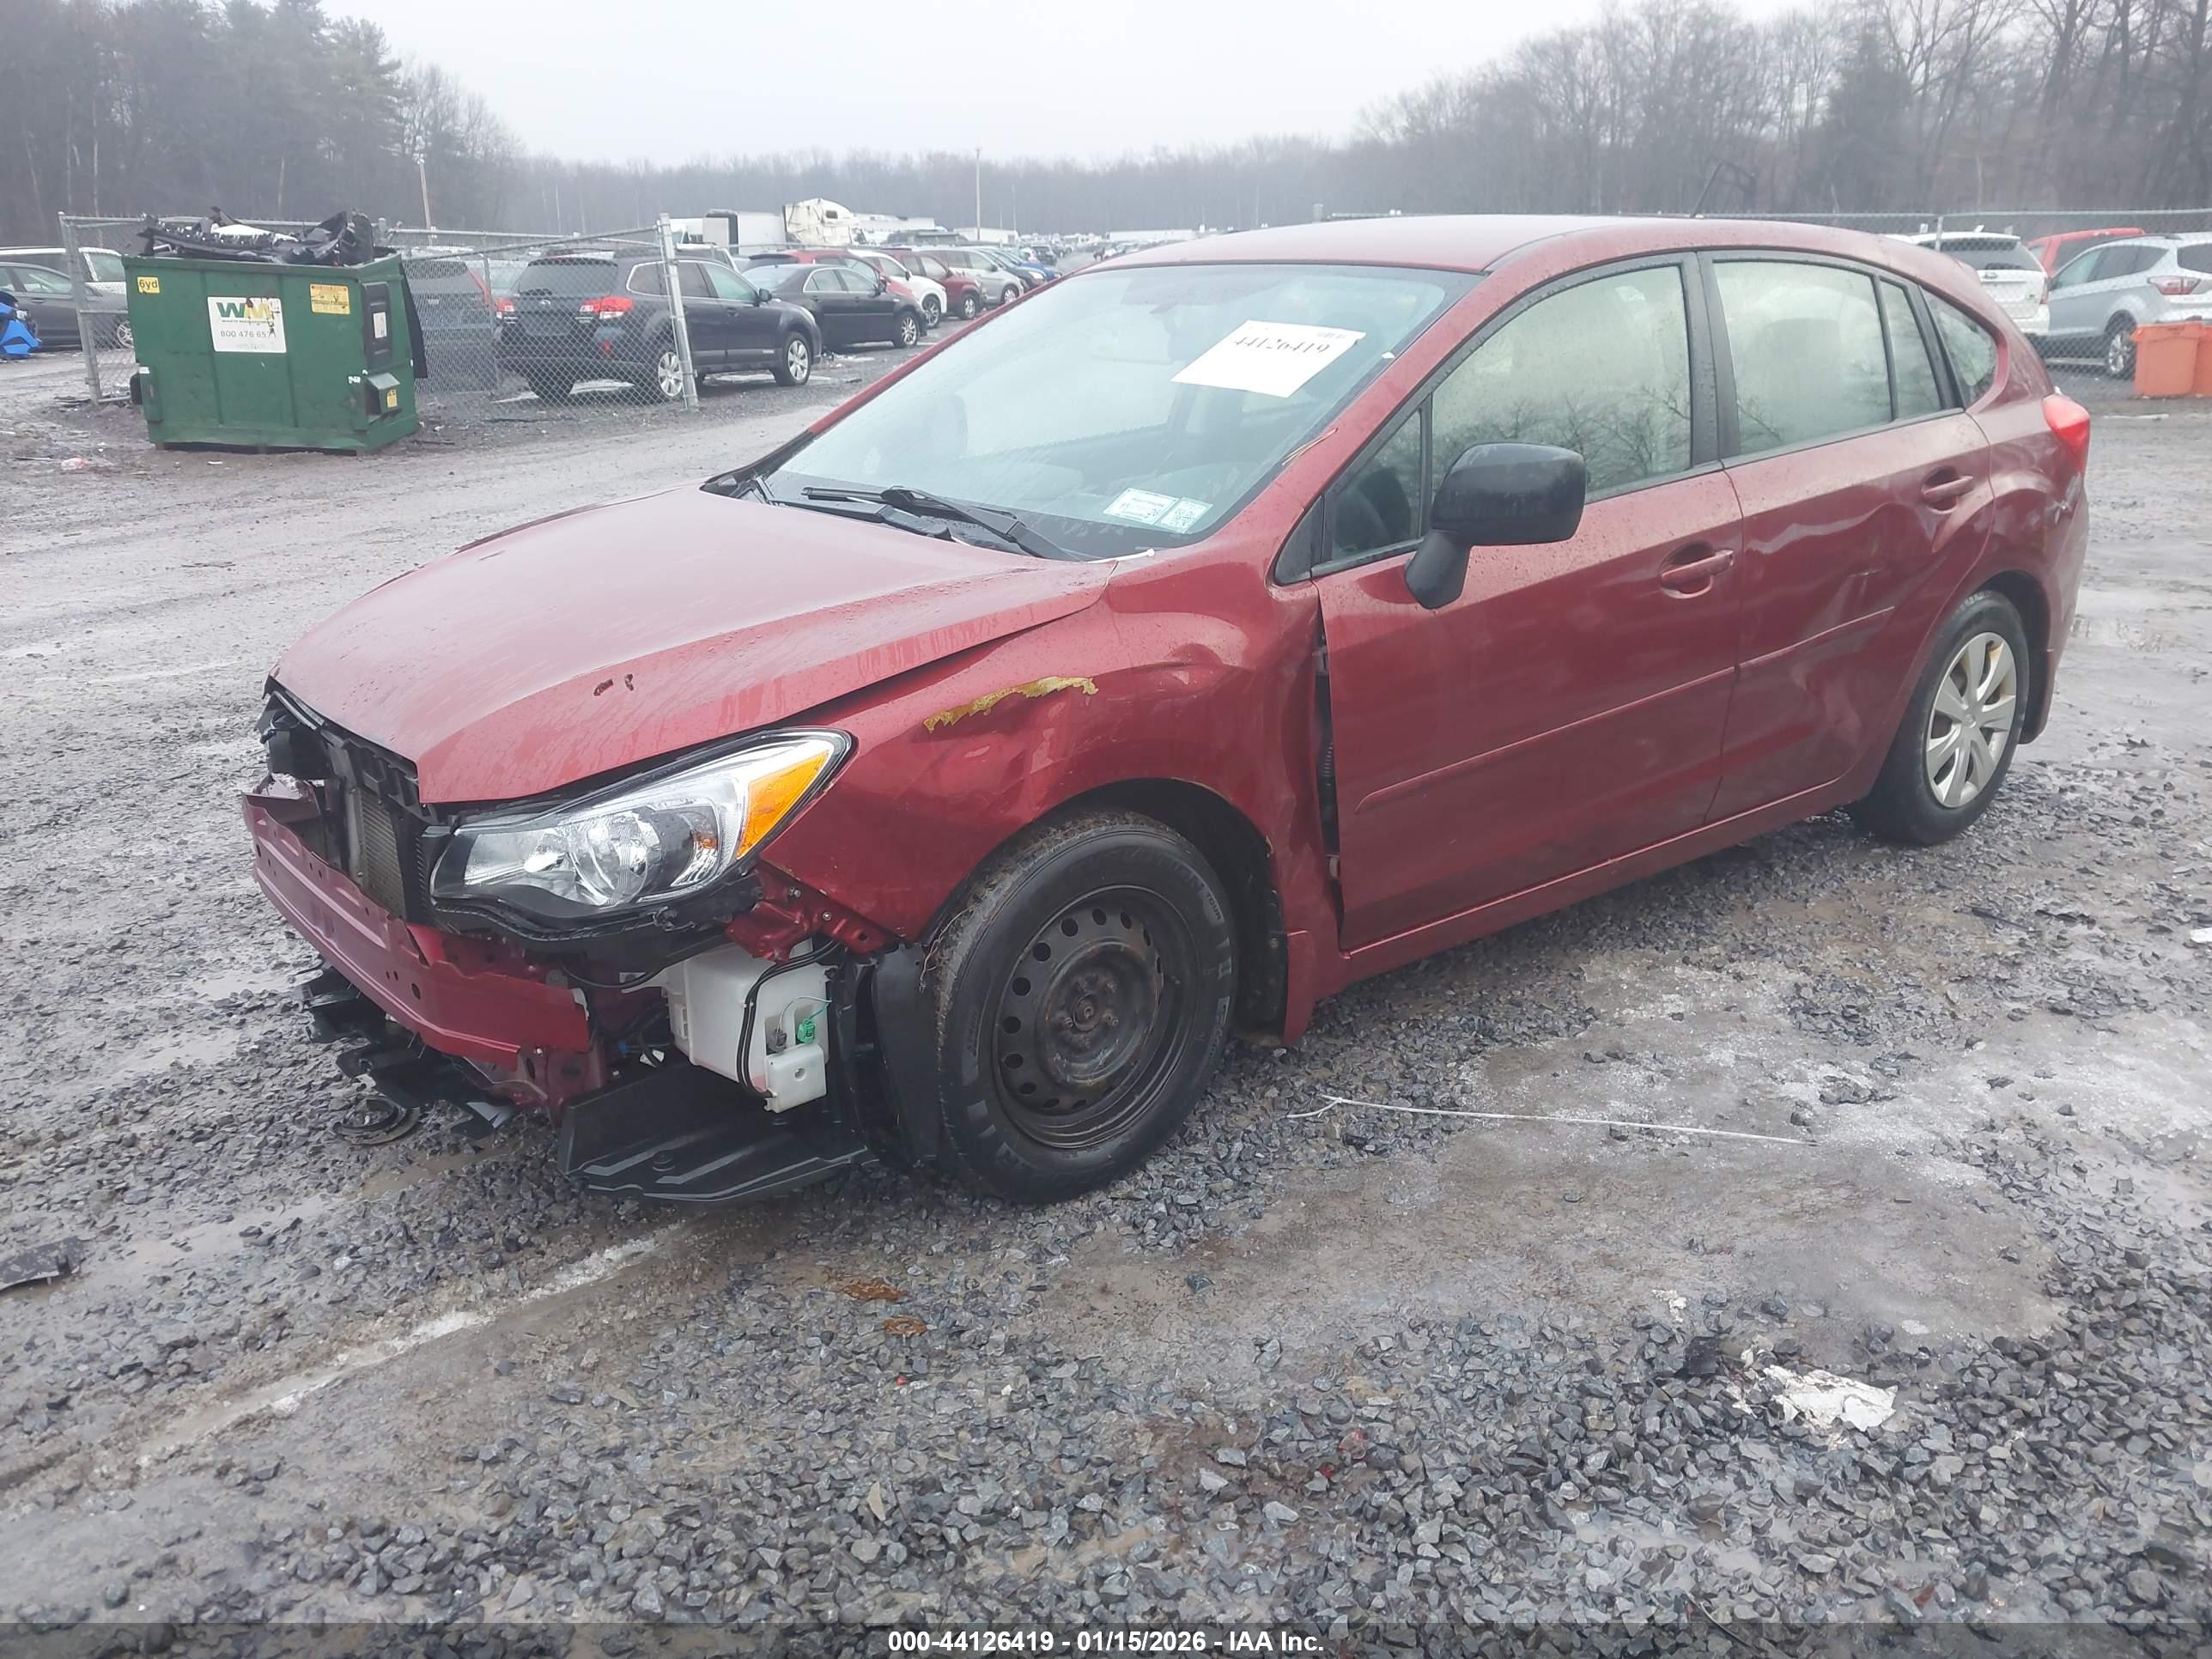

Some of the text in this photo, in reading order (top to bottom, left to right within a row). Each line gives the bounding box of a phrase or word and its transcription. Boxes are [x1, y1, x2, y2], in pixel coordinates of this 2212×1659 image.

[139, 279, 158, 290] 6yd
[216, 302, 272, 319] WM
[1206, 892, 1221, 921] TOUR
